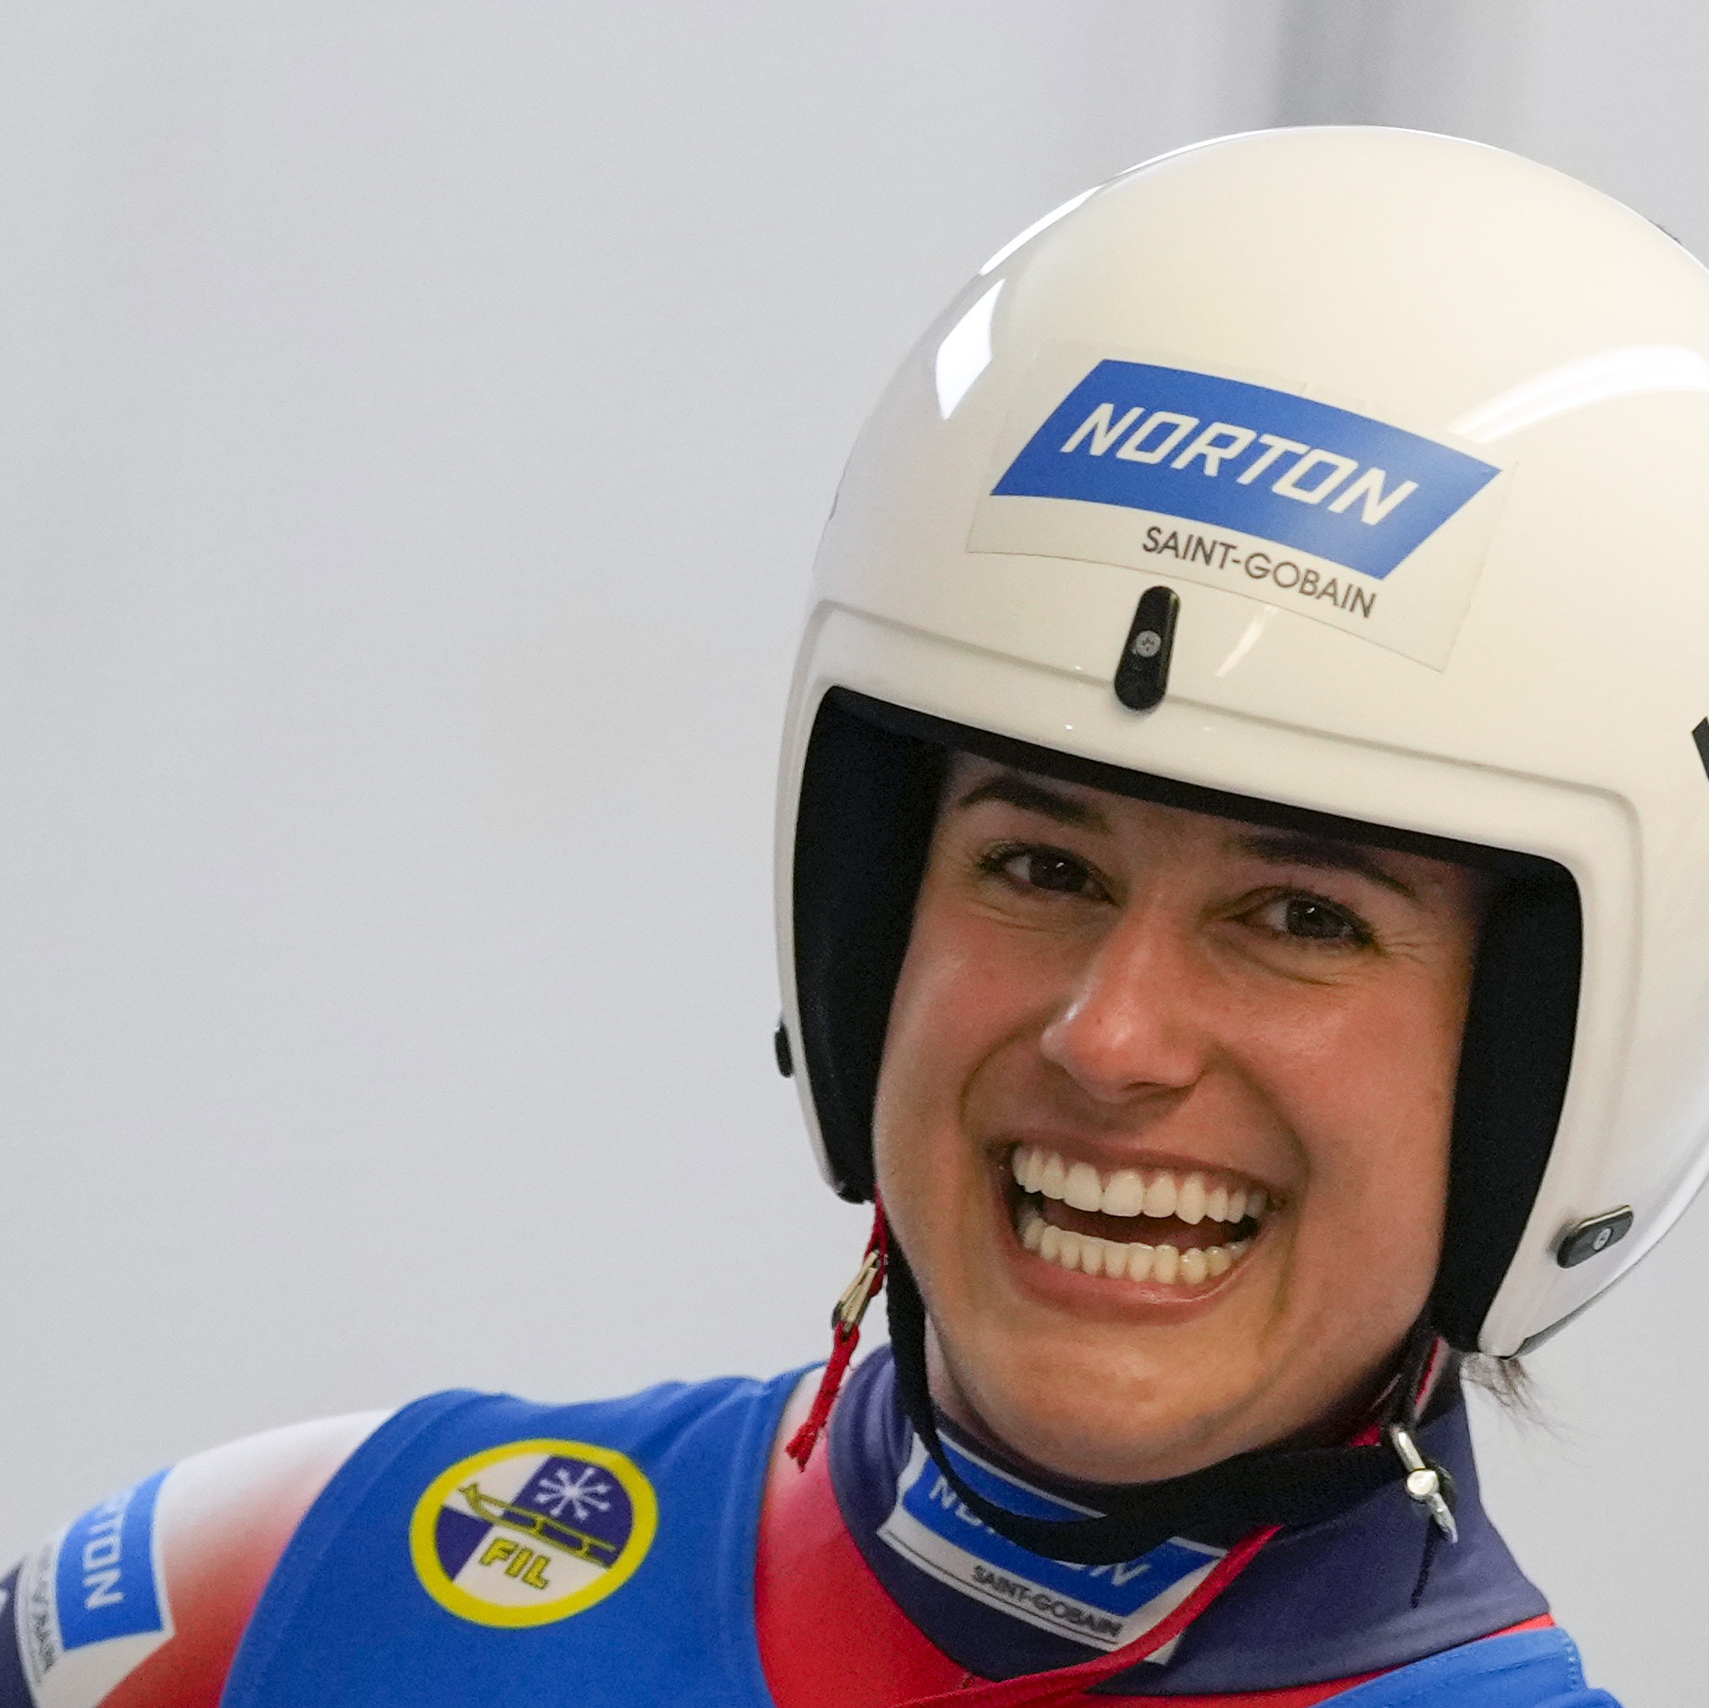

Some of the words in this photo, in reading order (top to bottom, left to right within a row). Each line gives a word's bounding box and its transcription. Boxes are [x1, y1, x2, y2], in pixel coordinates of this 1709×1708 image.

[1061, 402, 1419, 527] NORTON
[1142, 525, 1376, 620] SAINT-GOBAIN
[478, 1536, 552, 1591] FIL
